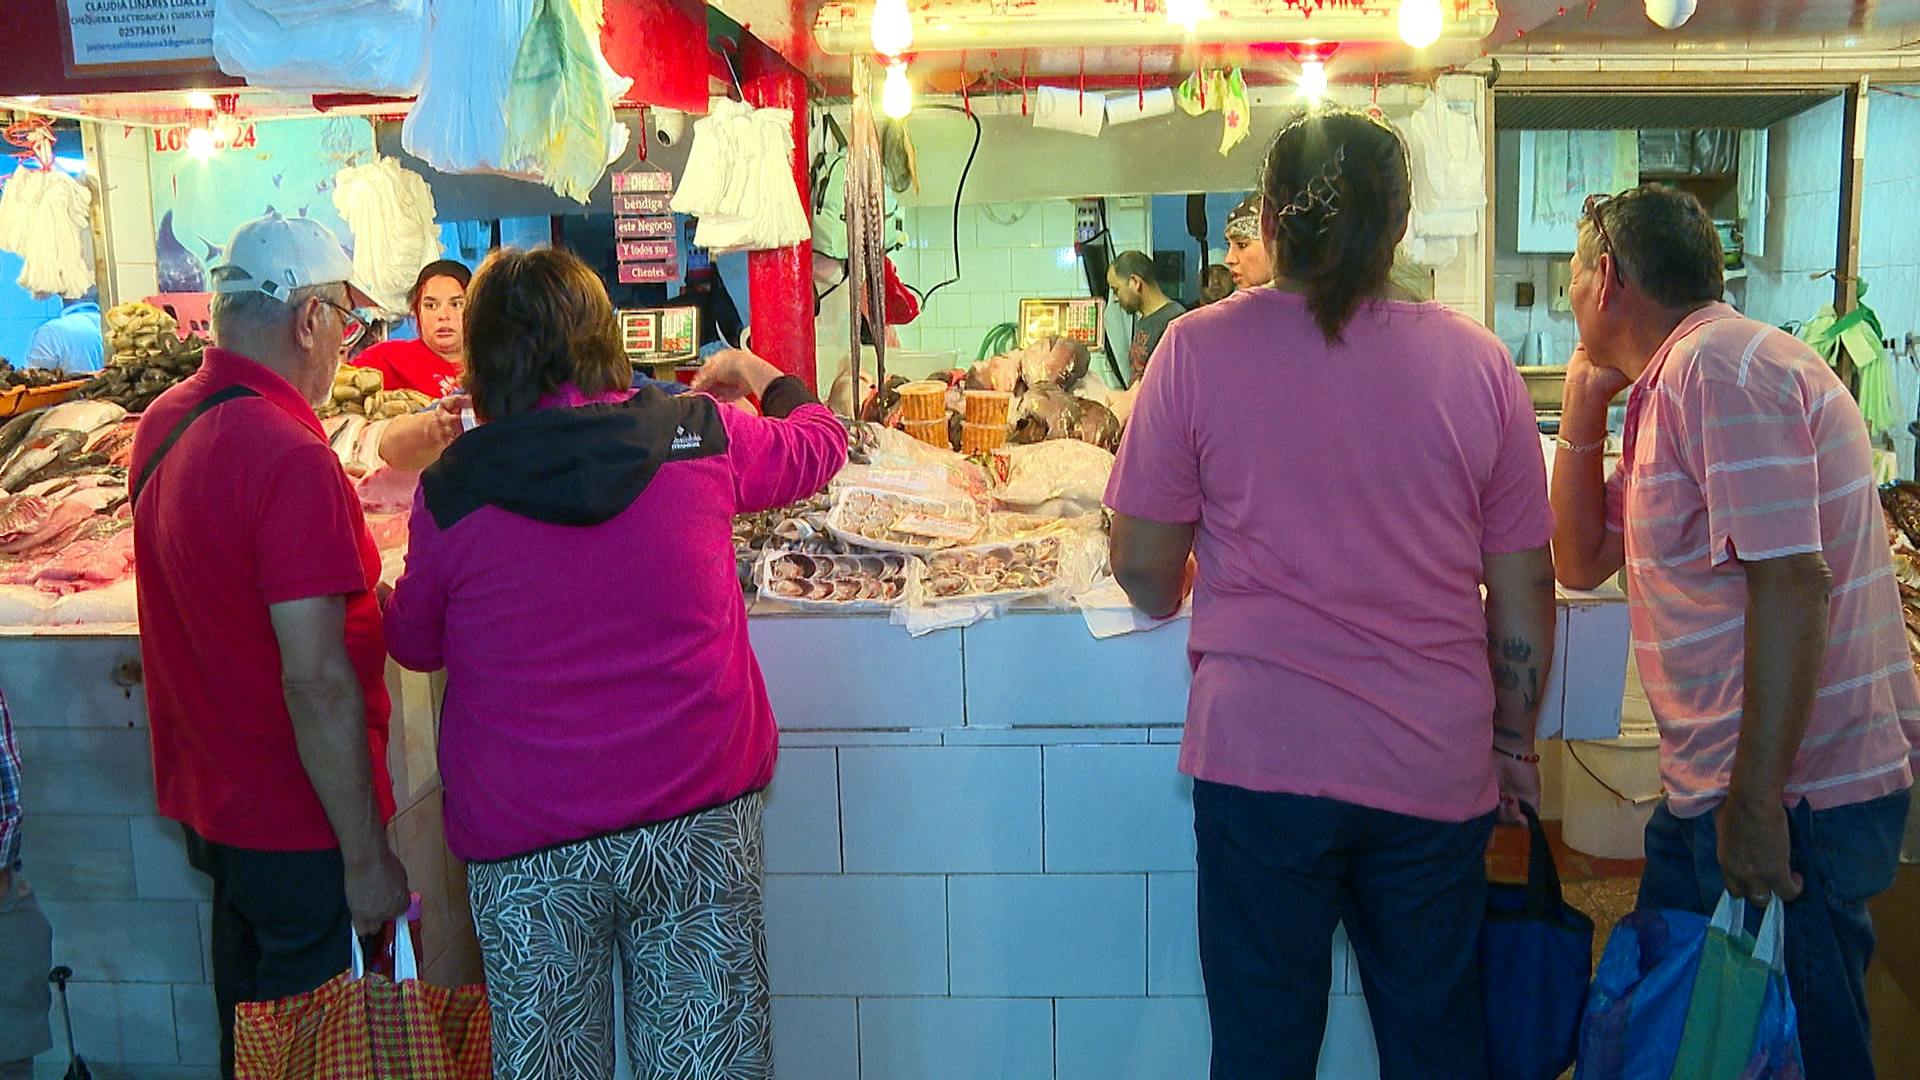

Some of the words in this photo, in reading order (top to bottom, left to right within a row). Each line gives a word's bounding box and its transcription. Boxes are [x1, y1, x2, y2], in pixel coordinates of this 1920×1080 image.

[85, 0, 127, 12] CLAUDIA
[129, 0, 168, 9] LINARES
[232, 123, 257, 149] 24
[630, 174, 655, 190] Dios
[623, 196, 663, 213] bendiga
[618, 222, 636, 233] este
[637, 219, 673, 236] Negocio
[622, 244, 630, 256] Y
[631, 243, 654, 256] todos
[655, 245, 669, 255] sus
